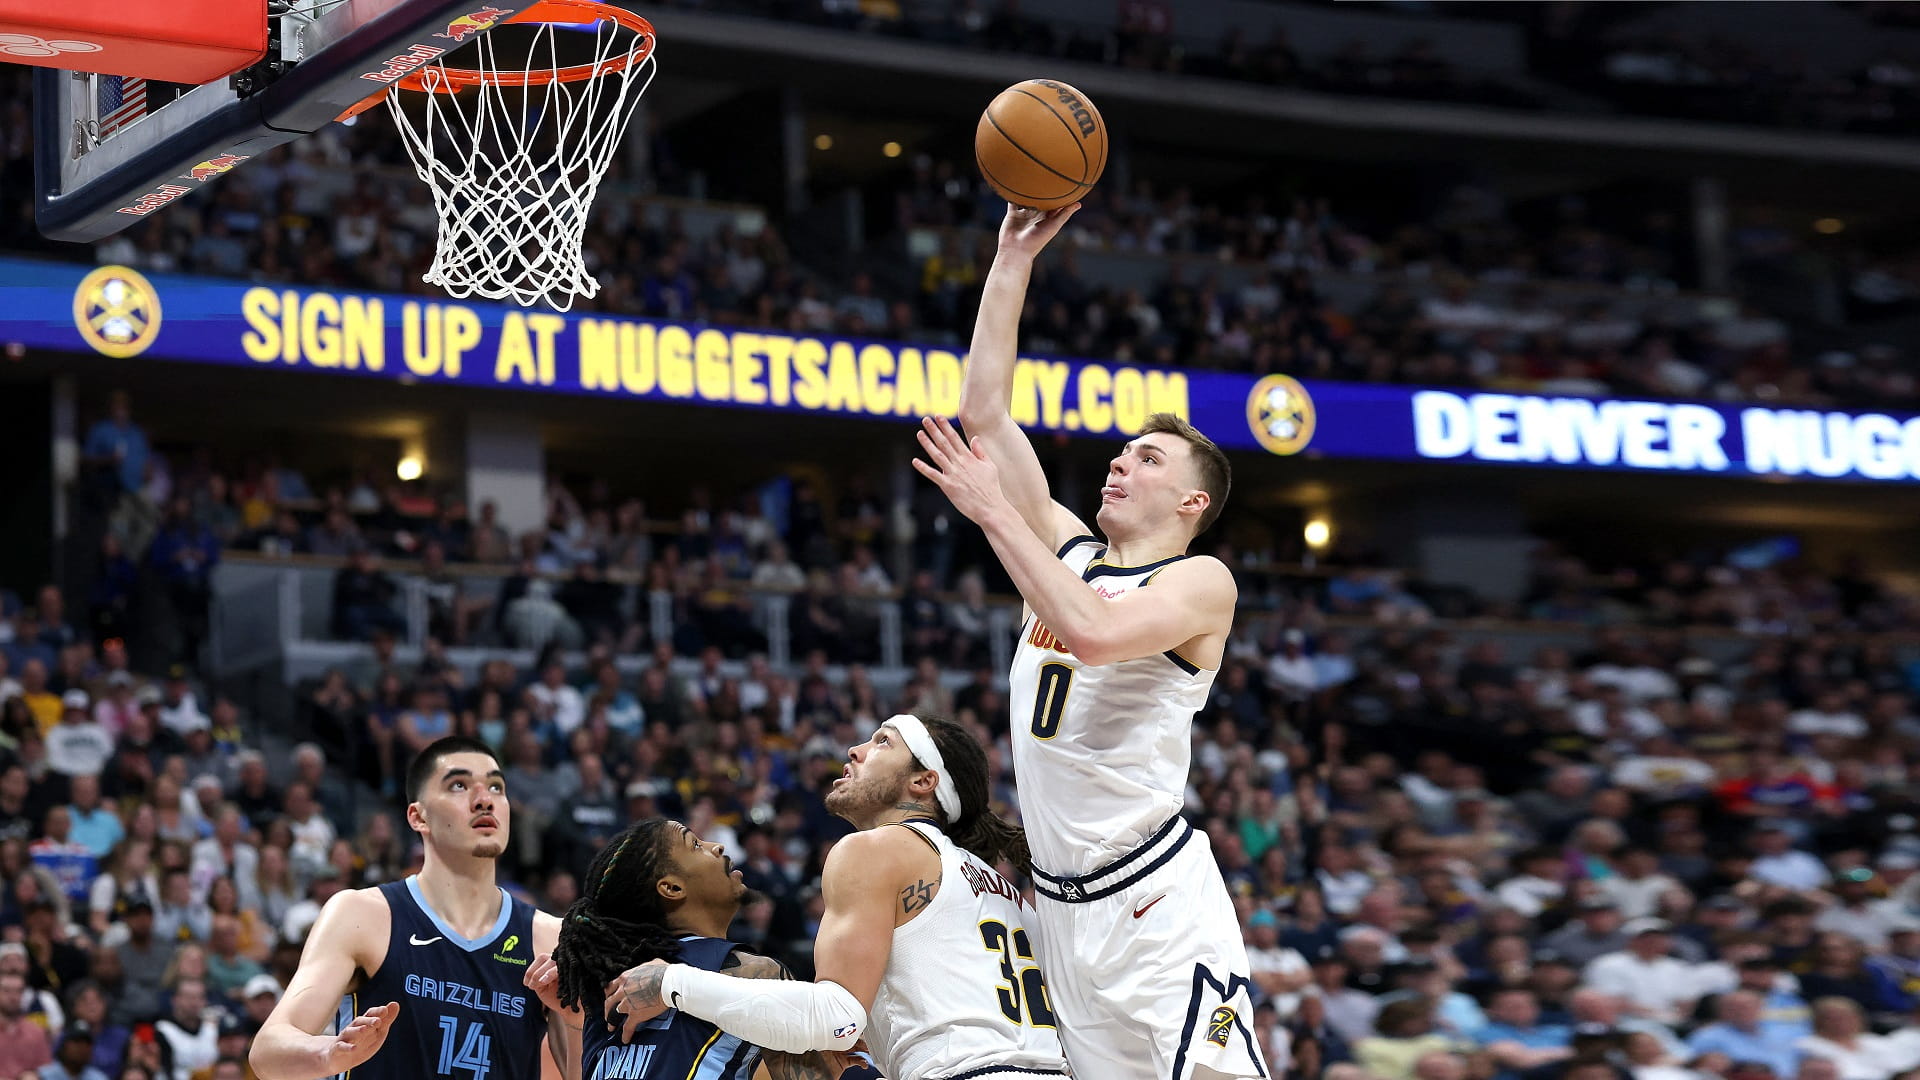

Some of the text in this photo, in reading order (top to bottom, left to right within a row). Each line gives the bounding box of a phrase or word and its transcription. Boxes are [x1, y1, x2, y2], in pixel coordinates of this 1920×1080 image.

[241, 287, 1189, 435] SIGN UP AT NUGGETSACADMY.COM
[1413, 390, 1730, 471] DENVER
[1030, 661, 1075, 740] 0
[404, 974, 526, 1018] GRIZZLIES
[493, 953, 527, 966] Robinhood
[978, 919, 1057, 1029] 32
[437, 1015, 491, 1080] 14
